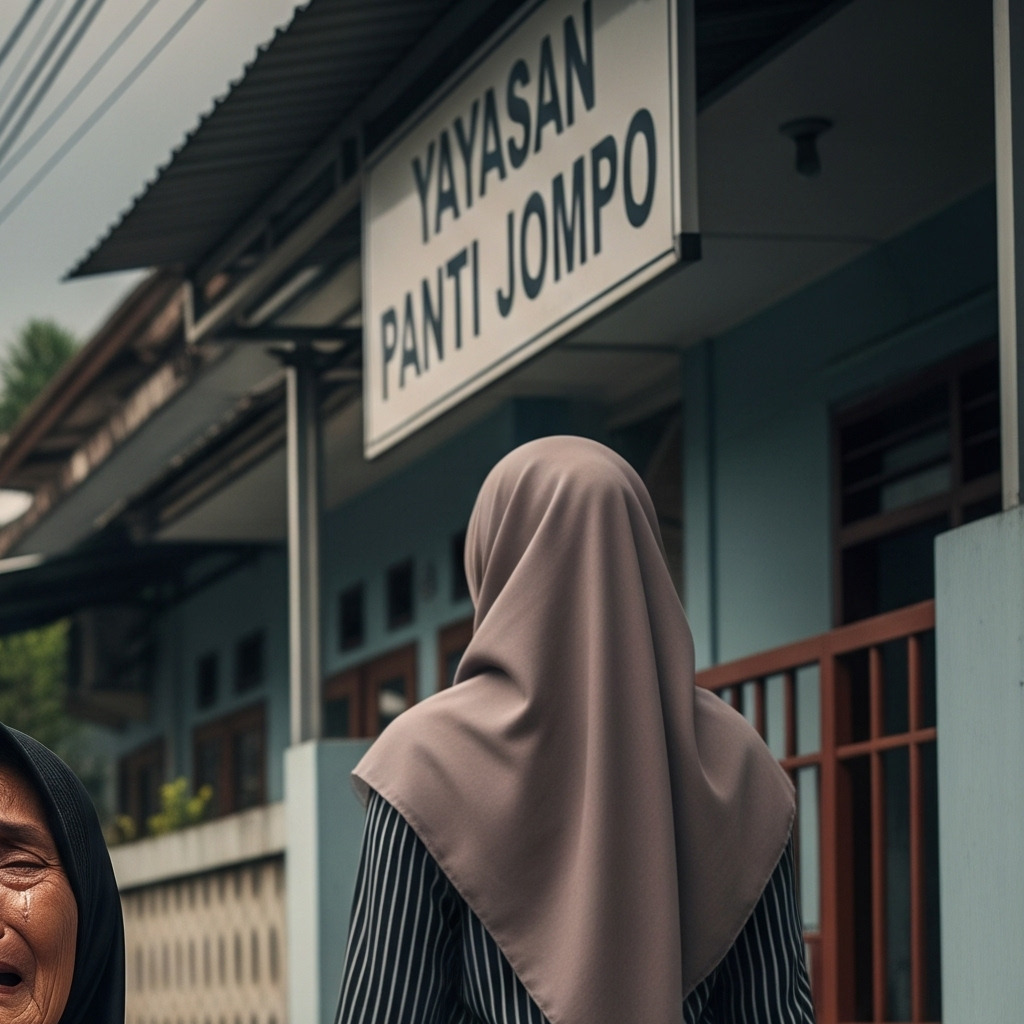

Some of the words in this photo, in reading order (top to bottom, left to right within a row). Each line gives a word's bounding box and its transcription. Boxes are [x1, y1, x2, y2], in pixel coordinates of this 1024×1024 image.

[381, 239, 479, 401] PANTI
[497, 108, 657, 318] JOMPO
[412, 0, 595, 243] YAYASAN
